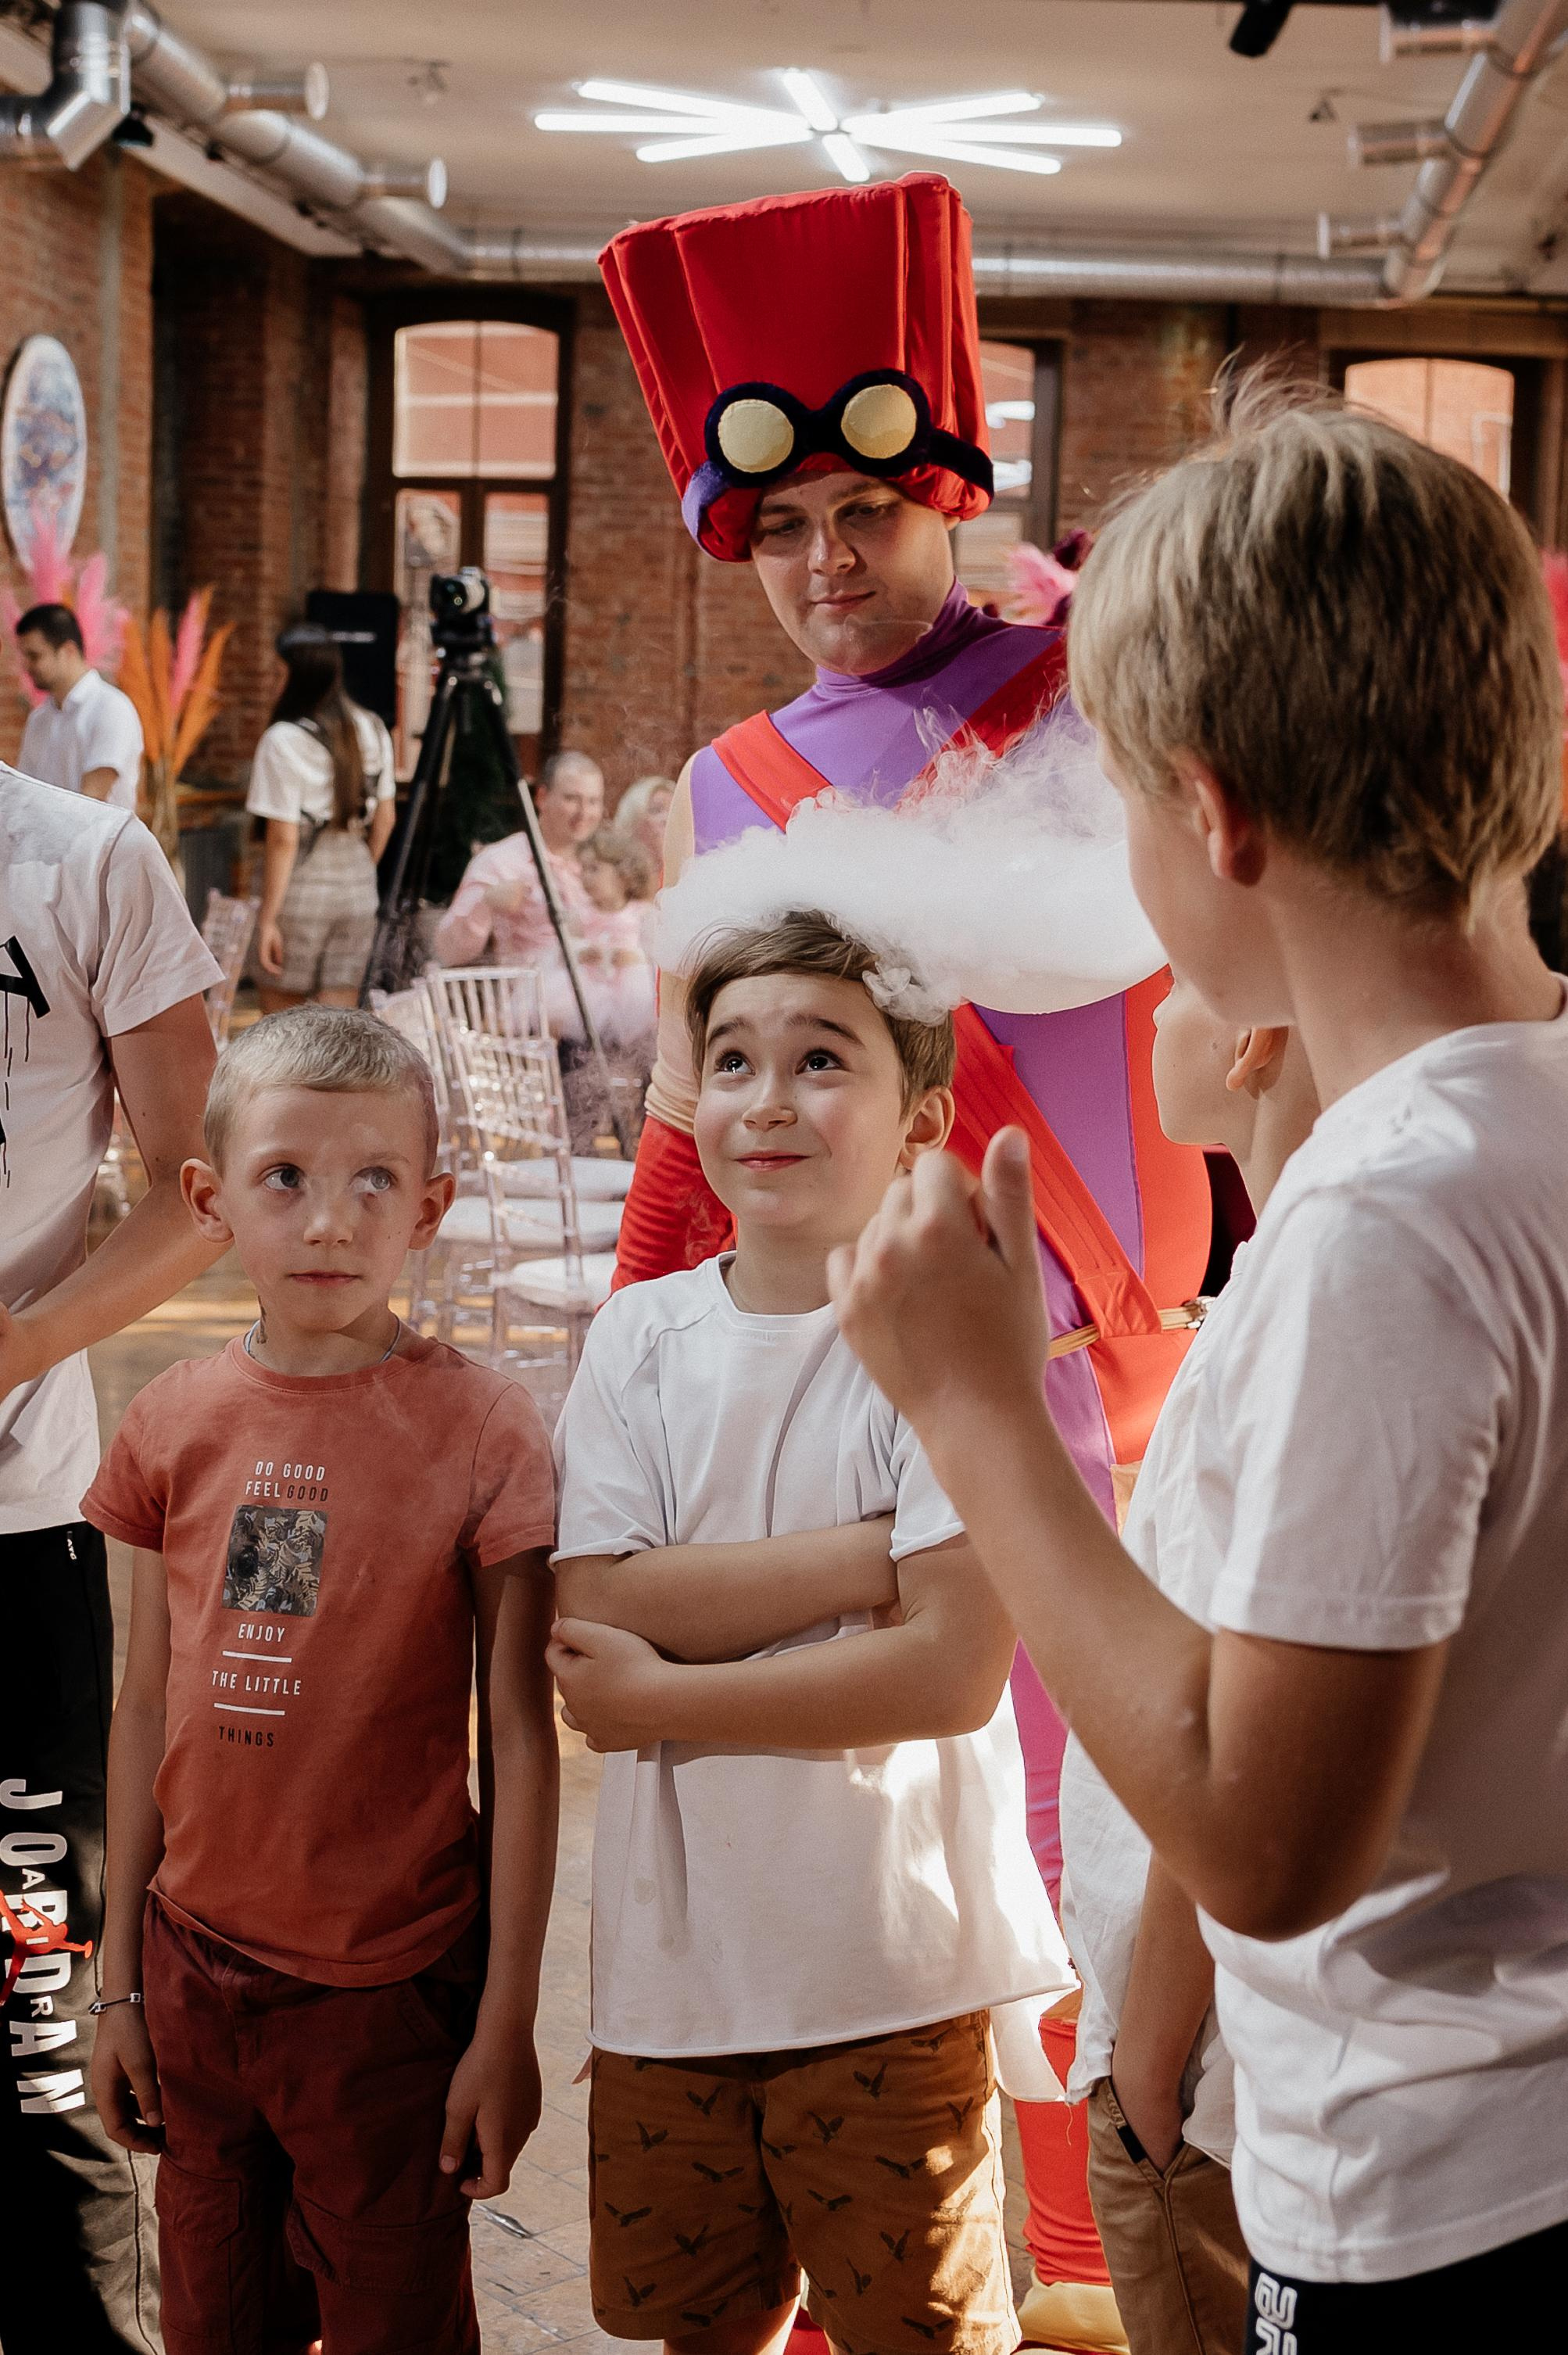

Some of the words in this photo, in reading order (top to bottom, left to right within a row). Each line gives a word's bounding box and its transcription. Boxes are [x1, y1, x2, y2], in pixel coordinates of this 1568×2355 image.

[255, 1461, 274, 1476] DO
[283, 1463, 325, 1481] GOOD
[245, 1481, 281, 1498] FEEL
[287, 1485, 328, 1501] GOOD
[238, 1623, 285, 1642] ENJOY
[212, 1670, 238, 1689] THE
[245, 1676, 302, 1695] LITTLE
[219, 1726, 274, 1747] THINGS
[0, 1778, 86, 2113] JORDAN
